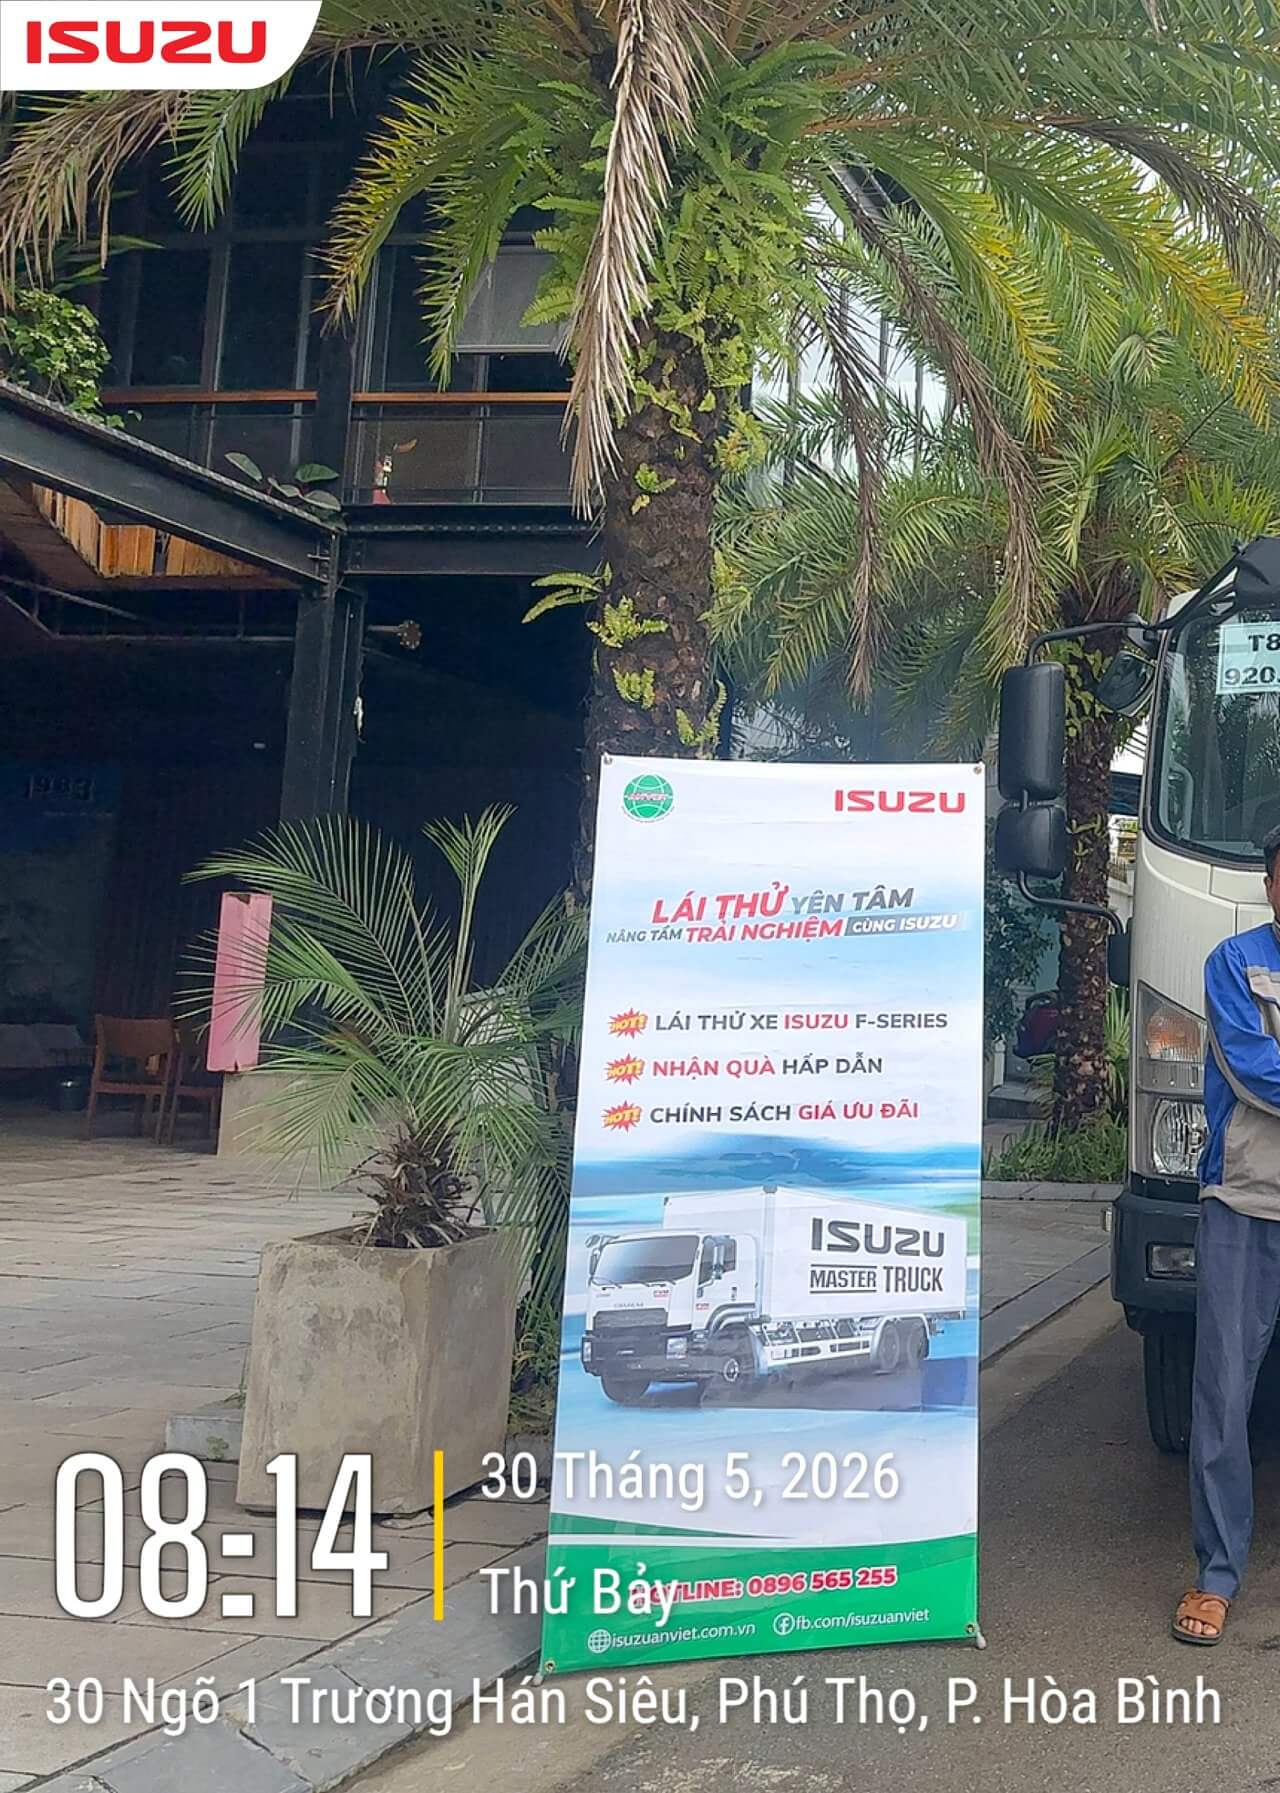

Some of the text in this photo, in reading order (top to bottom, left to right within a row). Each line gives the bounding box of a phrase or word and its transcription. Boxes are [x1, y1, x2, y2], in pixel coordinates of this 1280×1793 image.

[835, 790, 965, 813] ISUZU
[652, 881, 915, 924] LÁI THỬ YÊN TÂM
[606, 928, 647, 944] NÂNG
[687, 920, 736, 943] TRẢI
[741, 916, 844, 942] NGHIỆM
[852, 917, 896, 933] CÙNG
[900, 914, 958, 931] ISUZU
[656, 1010, 948, 1030] LÁI THỬ XE ISUZU F-SERIES
[653, 1051, 882, 1080] NHẬN QUÀ HẤP DẪN
[650, 1099, 918, 1123] CHÍNH SÁCH GIÁ ƯU ĐÃI
[811, 1217, 945, 1258] ISUZU
[810, 1266, 943, 1293] MASTER TRUCK
[748, 1574, 805, 1596] 0896
[812, 1571, 851, 1590] 565
[857, 1567, 896, 1586] 255
[796, 1607, 929, 1630] fb.com/isuzuanviet
[612, 1623, 756, 1648] isuzuanviet.com.vn
